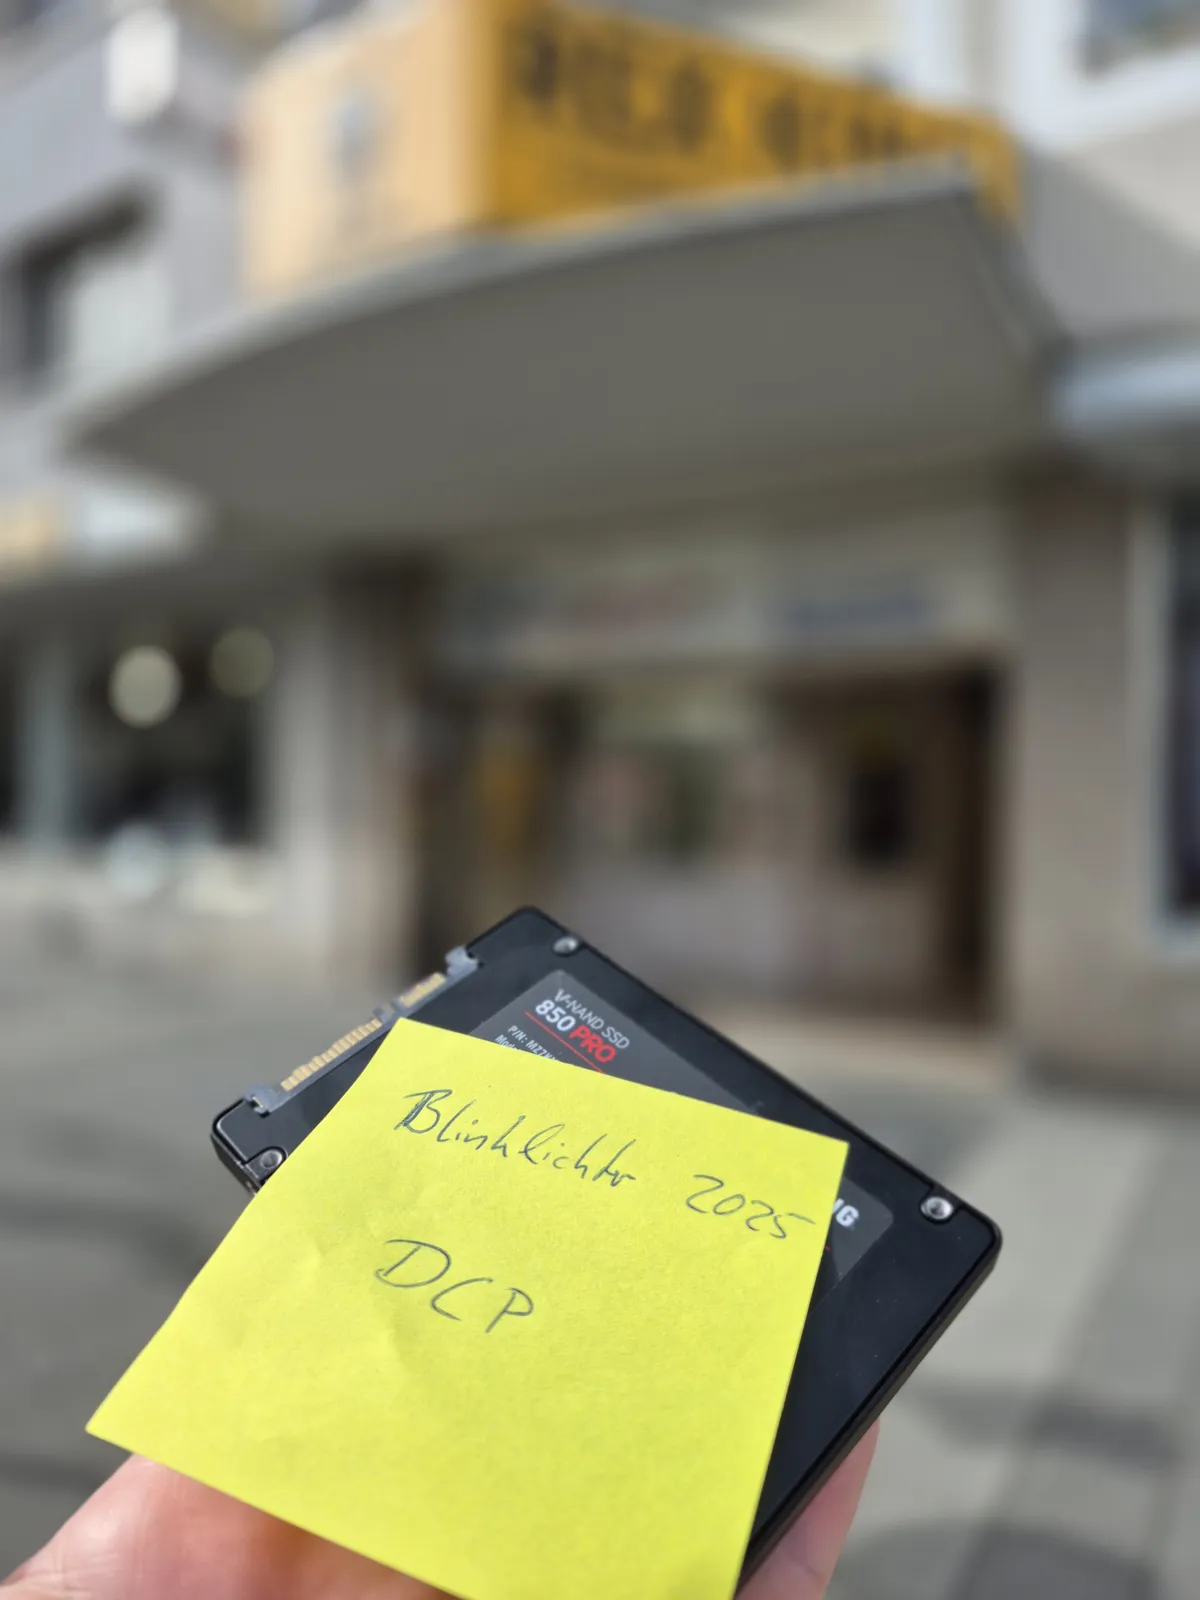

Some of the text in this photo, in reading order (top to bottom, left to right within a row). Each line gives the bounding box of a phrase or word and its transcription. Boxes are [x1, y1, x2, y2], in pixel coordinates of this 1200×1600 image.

[508, 1025, 528, 1043] P/N:
[535, 999, 616, 1063] 850 PRO
[555, 988, 630, 1049] V-NAND SSD
[685, 1173, 816, 1240] 2025
[374, 1238, 535, 1334] DCP
